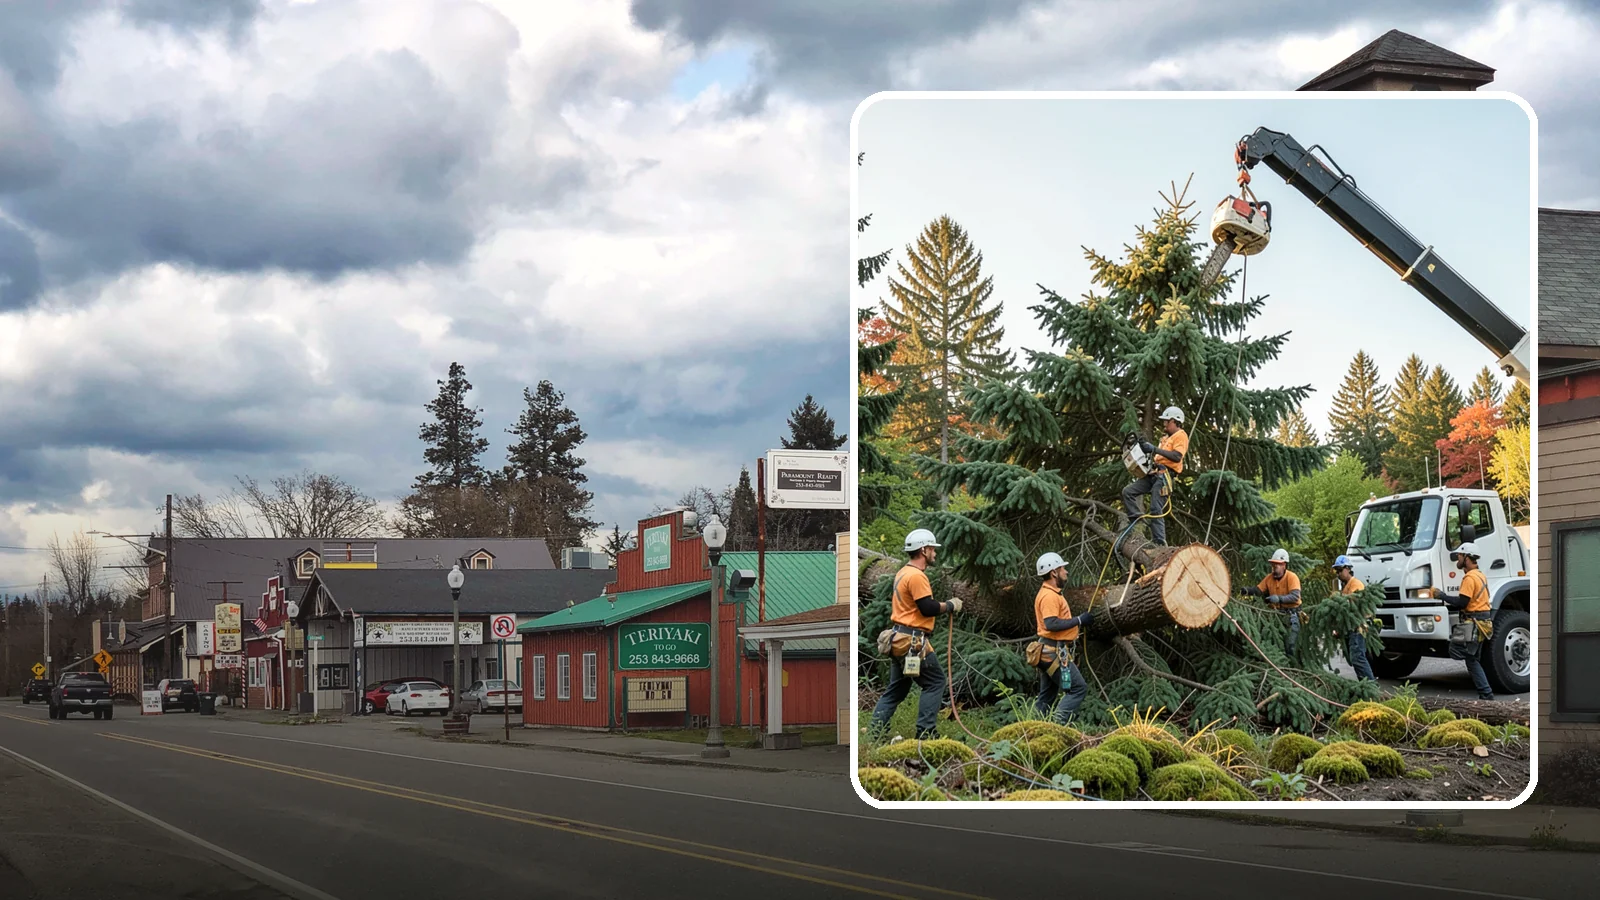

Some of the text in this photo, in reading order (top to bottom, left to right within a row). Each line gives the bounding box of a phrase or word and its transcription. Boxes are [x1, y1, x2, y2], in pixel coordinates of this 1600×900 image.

[625, 627, 702, 646] TERIYAKI
[654, 643, 677, 651] TO GO
[629, 653, 700, 664] 253 843-9668
[639, 681, 673, 691] TERIYAKI
